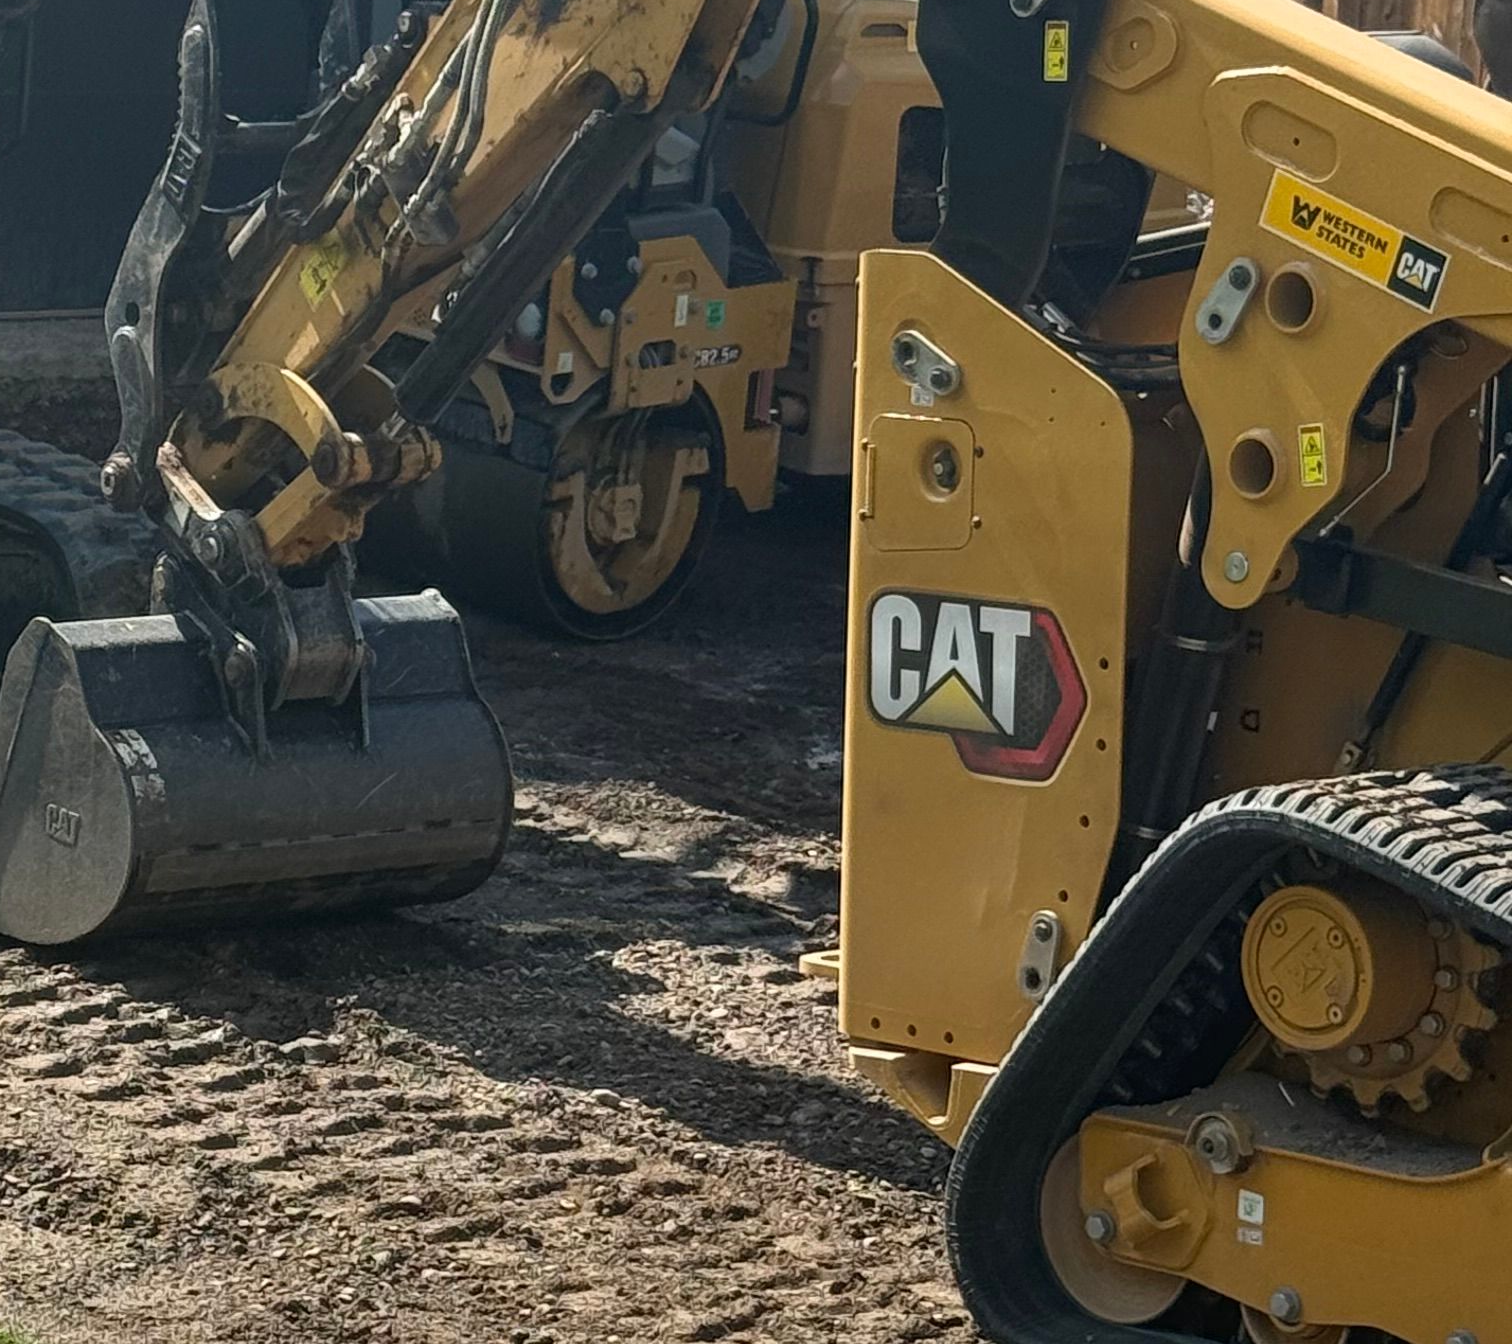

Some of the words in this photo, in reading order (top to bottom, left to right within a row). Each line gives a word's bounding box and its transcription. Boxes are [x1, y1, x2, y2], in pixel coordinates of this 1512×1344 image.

[1316, 226, 1366, 260] STATES
[1322, 209, 1389, 255] WESTERN
[1396, 252, 1440, 293] CAT
[871, 594, 1031, 737] CAT
[46, 803, 82, 847] CAT
